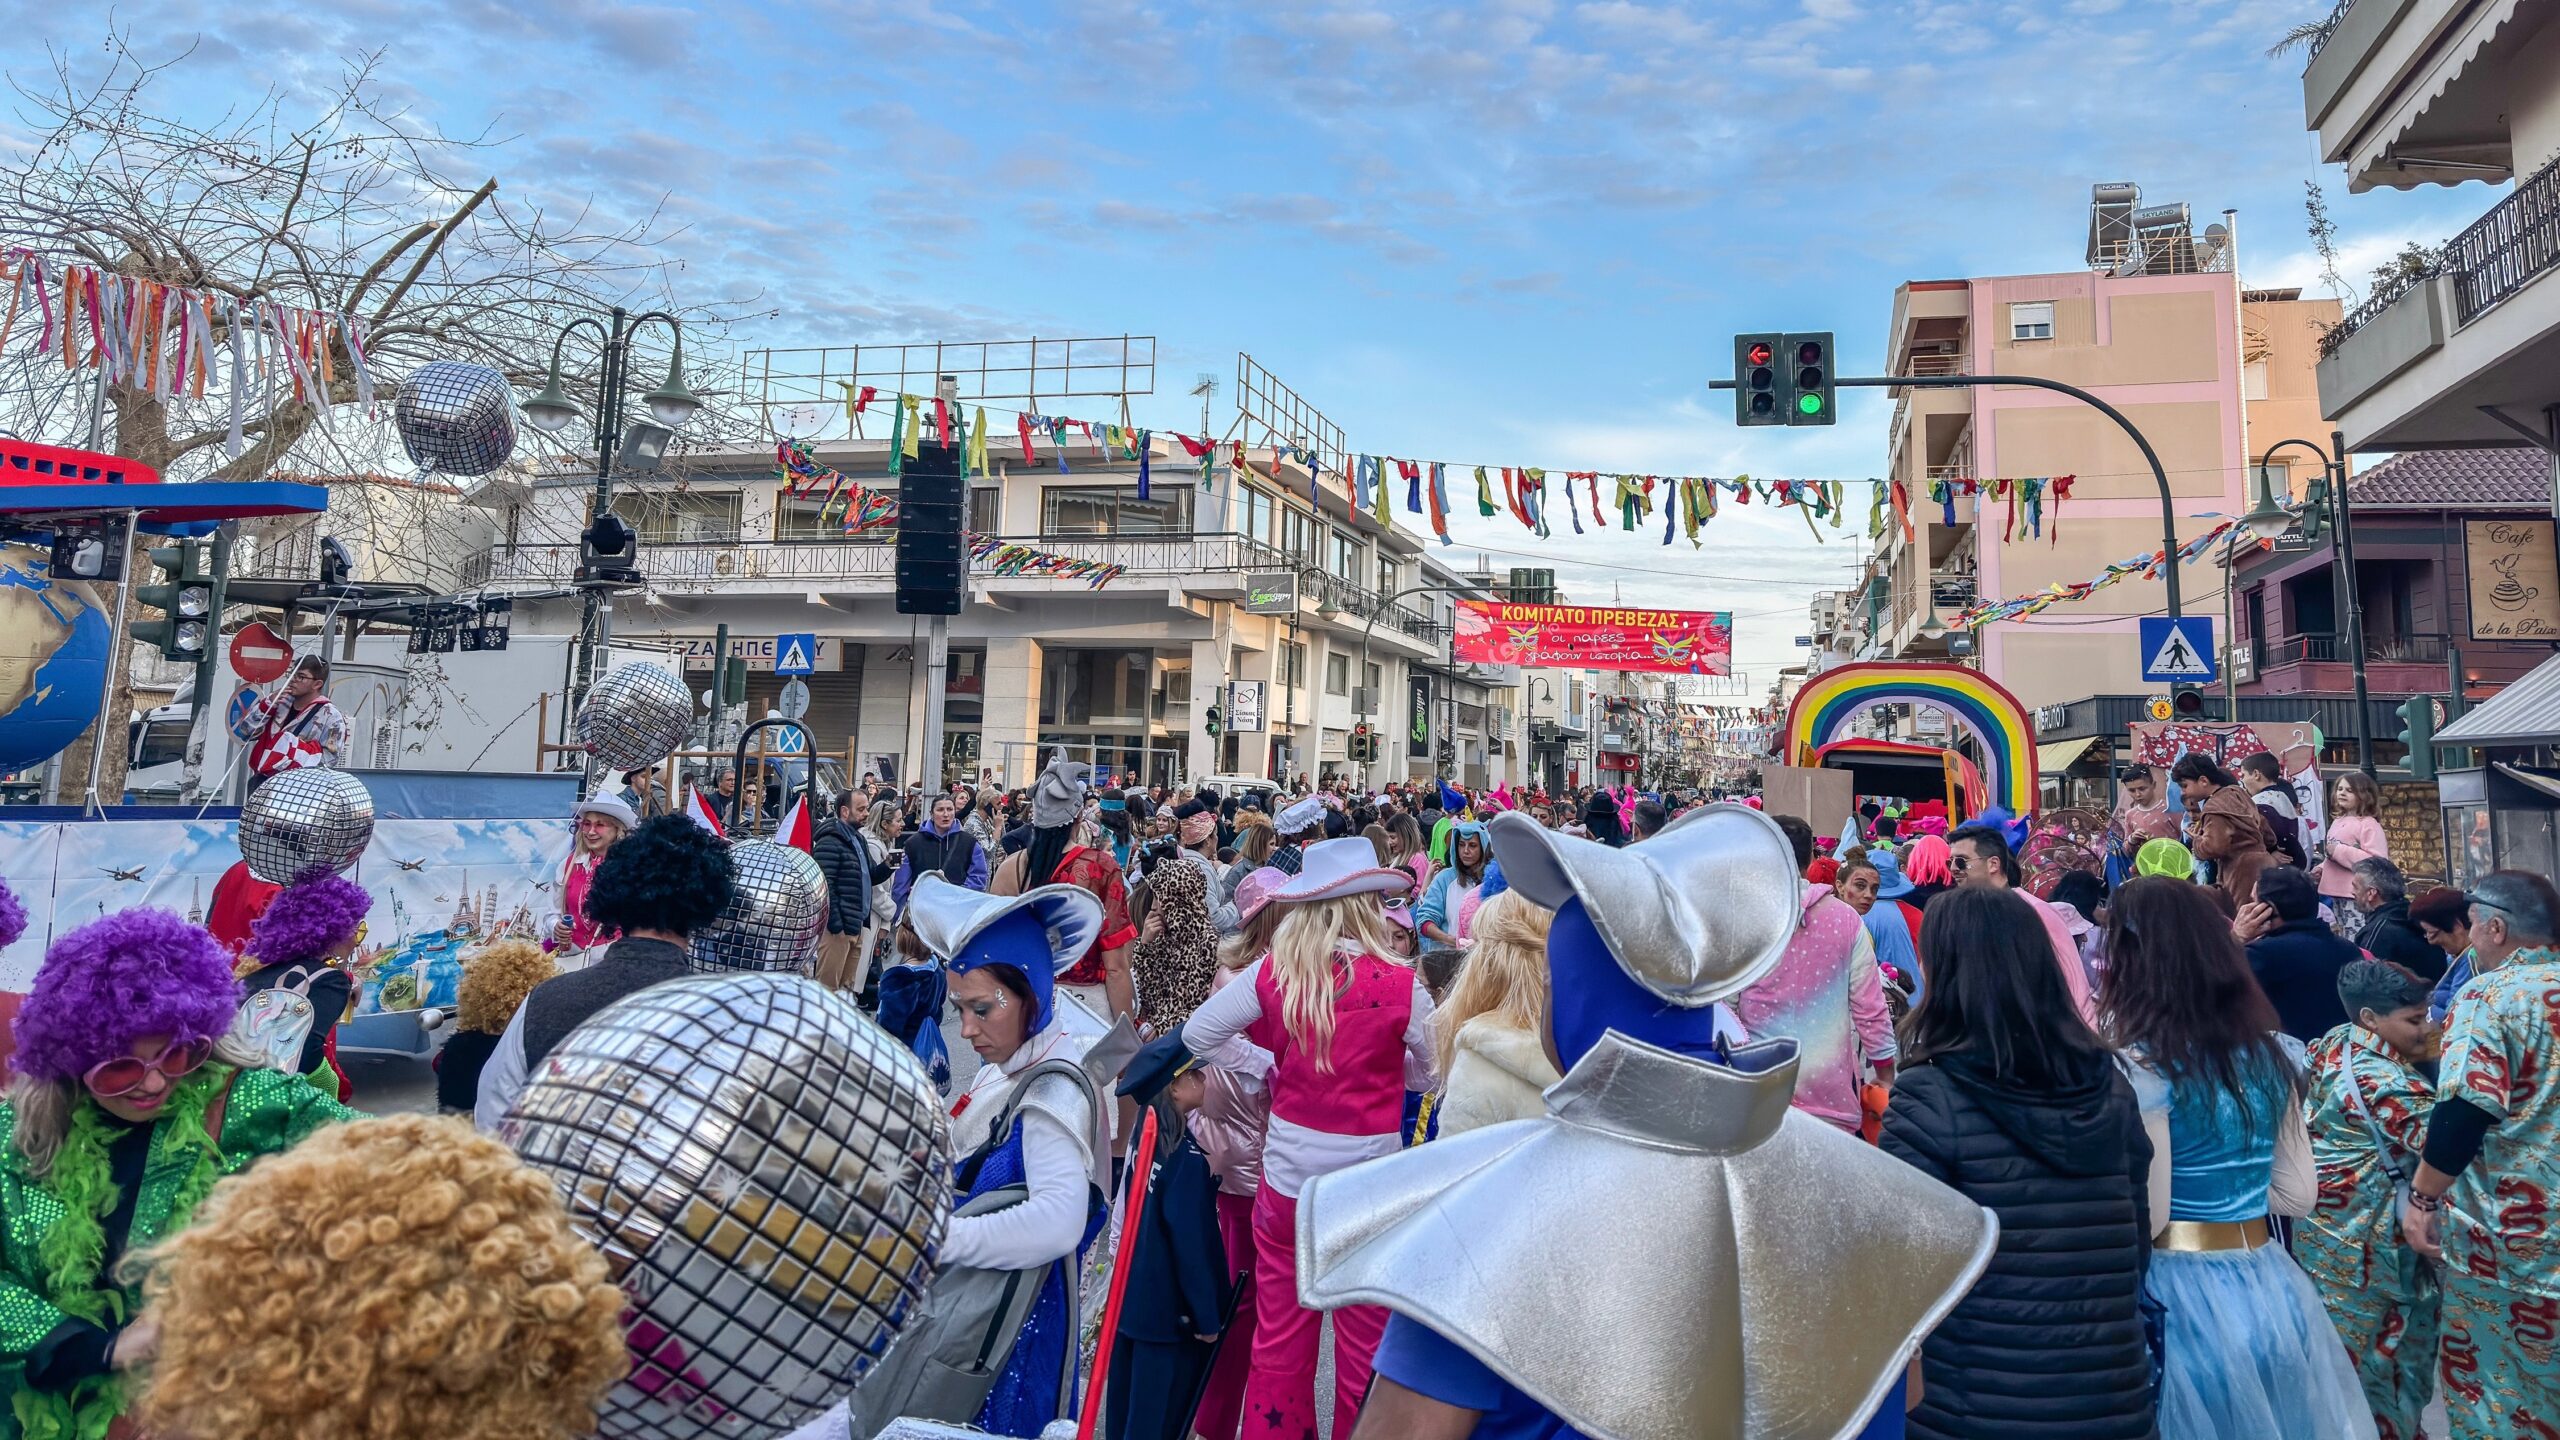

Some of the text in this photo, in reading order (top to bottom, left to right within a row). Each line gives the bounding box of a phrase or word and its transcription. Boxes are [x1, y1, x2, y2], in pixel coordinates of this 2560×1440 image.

[2142, 209, 2174, 219] SKYLAND
[1502, 606, 1679, 628] ΚΟΜΙΤΑΤΟ ΠΡΕΒΕΖΑΣ
[2478, 618, 2557, 635] de la Paix
[1551, 634, 1565, 643] οι
